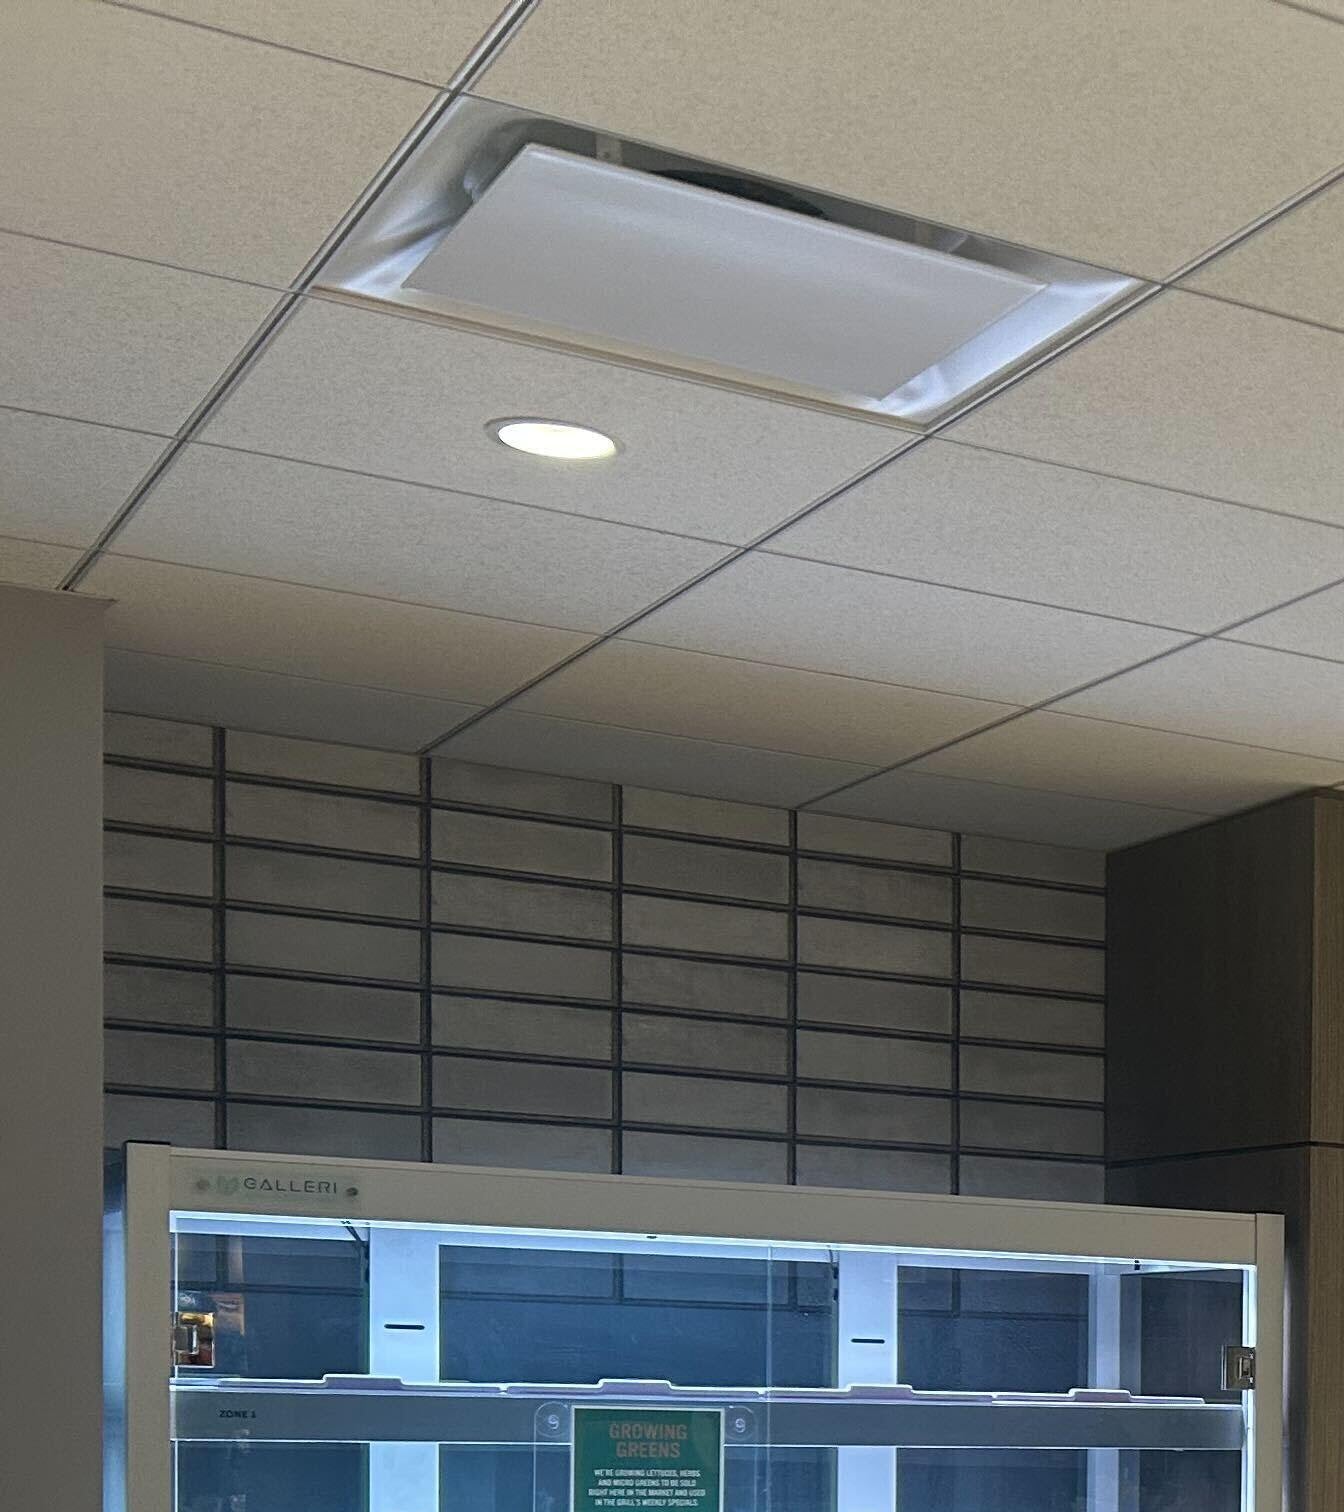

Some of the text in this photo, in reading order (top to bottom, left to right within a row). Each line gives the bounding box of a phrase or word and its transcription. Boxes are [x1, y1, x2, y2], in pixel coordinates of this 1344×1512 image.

[243, 1177, 337, 1194] GALLERI
[219, 1410, 247, 1418] ZONE
[609, 1423, 687, 1440] GROWING
[616, 1441, 680, 1458] GREENS
[598, 1479, 696, 1487] AND MICRO GREENS TO BE SOLD
[588, 1488, 706, 1497] RIGHT HERE IN THE MARKET AND USED
[595, 1498, 602, 1506] IN
[604, 1498, 615, 1506] THE
[642, 1498, 666, 1506] WEEKLY
